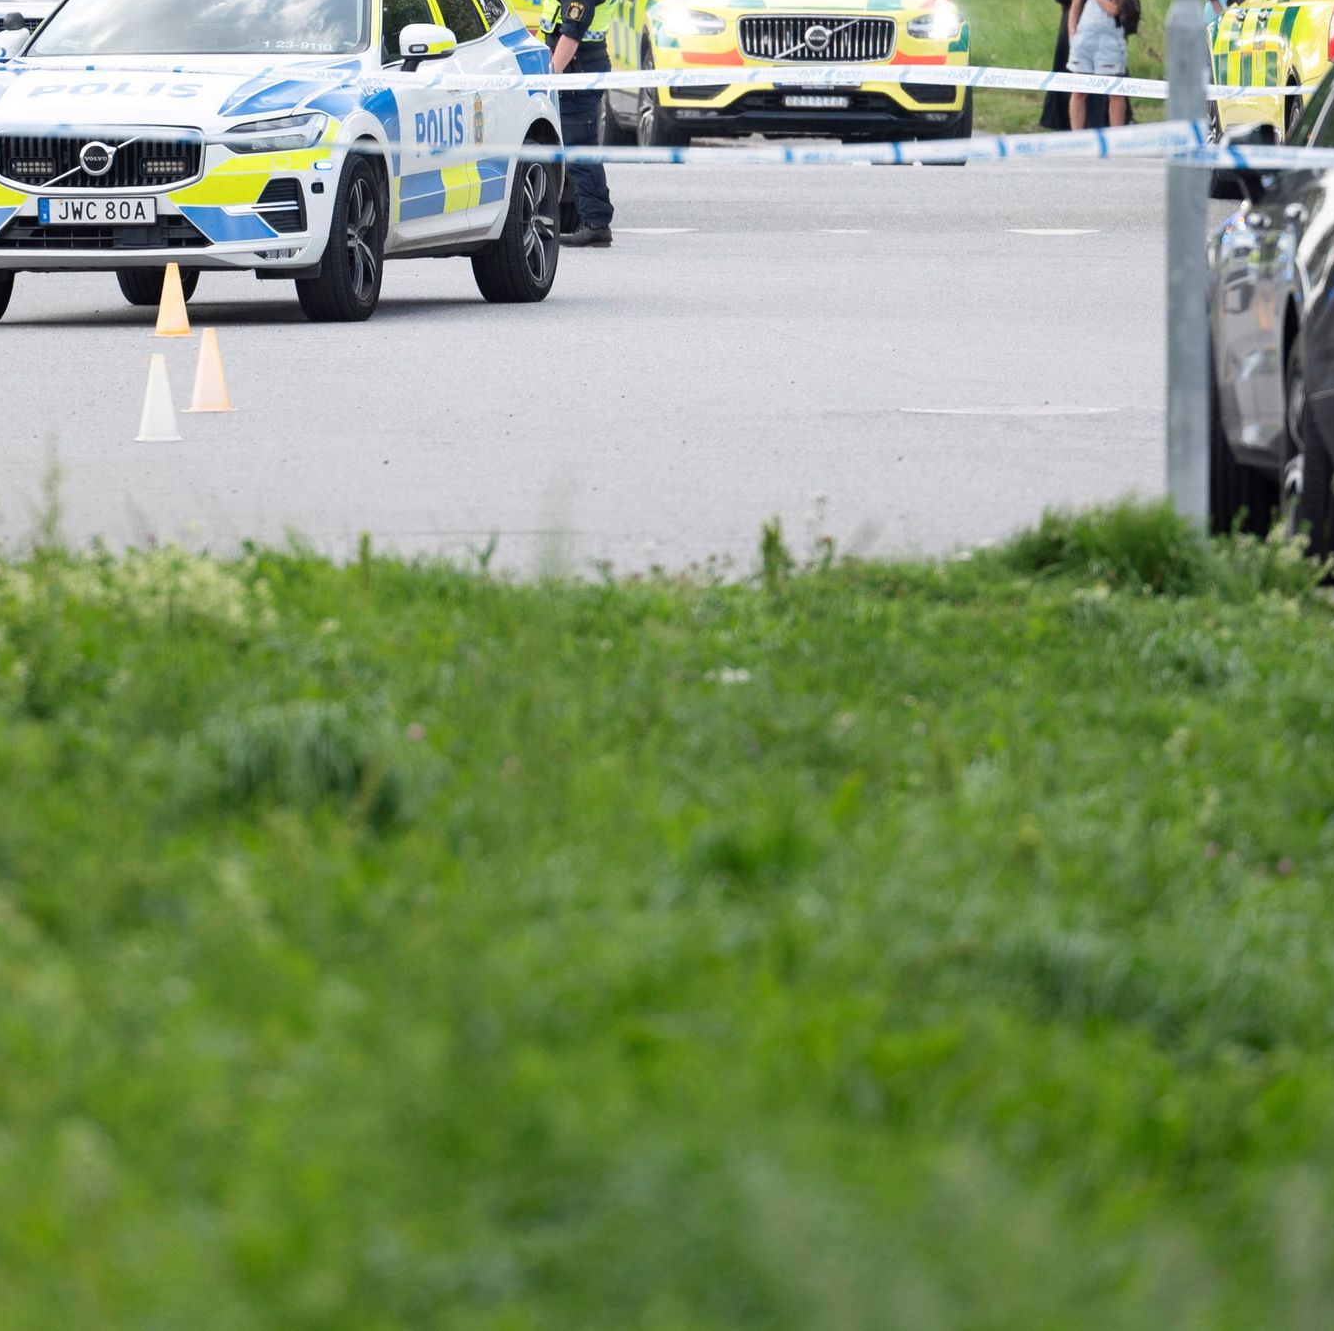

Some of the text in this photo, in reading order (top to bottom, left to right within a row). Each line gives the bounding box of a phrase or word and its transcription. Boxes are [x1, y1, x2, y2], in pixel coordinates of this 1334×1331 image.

[263, 40, 332, 51] 1 23-9110
[27, 82, 204, 98] POLIS
[415, 103, 464, 155] POLIS
[58, 201, 146, 221] JWC 80A
